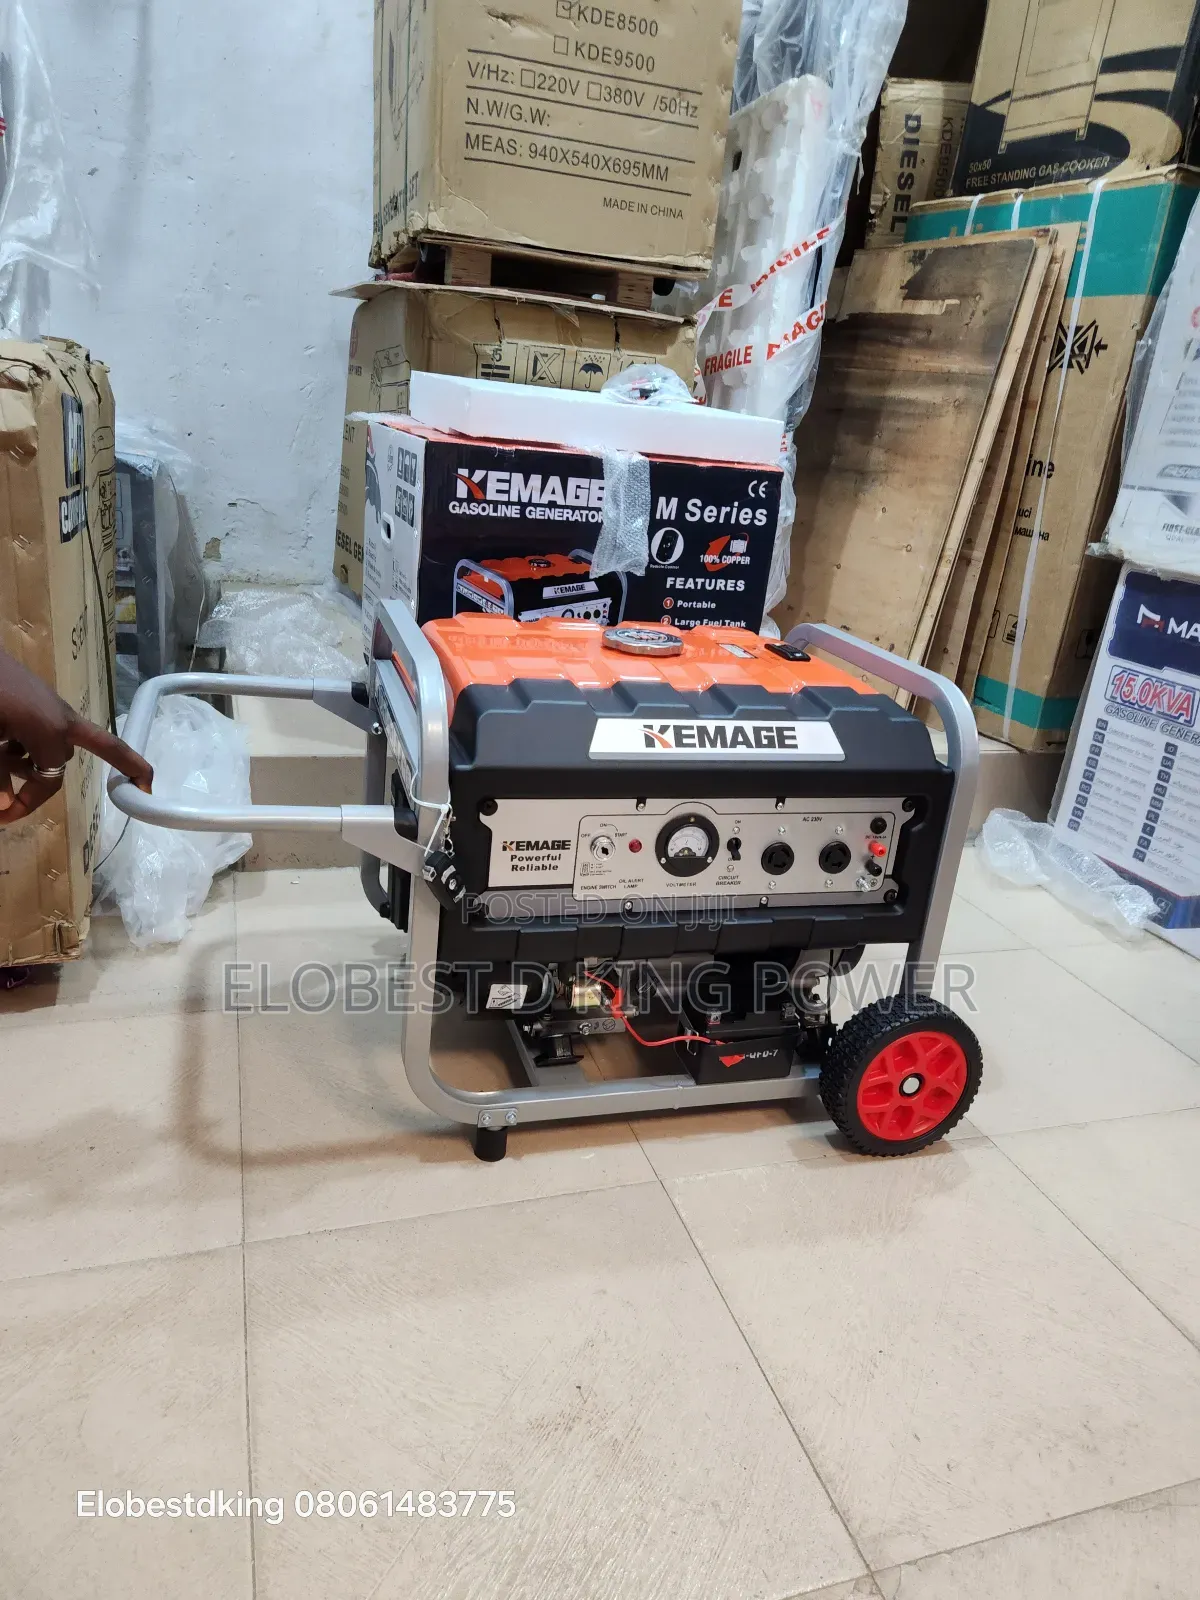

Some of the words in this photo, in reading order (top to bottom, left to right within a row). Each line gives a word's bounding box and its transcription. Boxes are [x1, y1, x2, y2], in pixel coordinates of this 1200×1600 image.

[577, 6, 659, 38] KDE8500
[574, 40, 656, 74] KDE9500
[467, 60, 516, 85] V/Hz:
[537, 71, 580, 96] 220V
[603, 84, 646, 108] 380V
[653, 93, 699, 120] /50Hz
[465, 97, 551, 128] N.W/G.W:
[465, 131, 524, 158] MEAS:
[528, 143, 670, 182] 940X540X695MM
[889, 114, 922, 233] DIESEL
[965, 176, 988, 189] FREE
[990, 167, 1036, 185] STANDING
[1038, 164, 1059, 177] GAS
[1060, 155, 1110, 175] COOKER
[602, 196, 636, 213] MADE
[637, 202, 648, 214] IN
[650, 203, 684, 220] CHINA
[704, 345, 753, 376] FRAGILE
[452, 468, 604, 508] KEMAGE
[449, 501, 521, 518] GASOLINE
[655, 496, 679, 521] M
[684, 498, 768, 526] Series
[1014, 526, 1050, 542] машна
[700, 554, 720, 564] 100%
[721, 555, 751, 565] COPPER
[666, 577, 746, 592] FEATURES
[676, 600, 717, 609] Portable
[674, 617, 700, 627] Large
[702, 618, 722, 627] Fuel
[725, 620, 746, 628] Tank
[1111, 671, 1195, 722] 15.0KVA
[1104, 703, 1159, 732] GASOLINE
[637, 724, 799, 750] KEMAGE
[500, 840, 572, 852] KEMAGE
[510, 853, 562, 863] Powerful
[511, 863, 559, 872] Reliable
